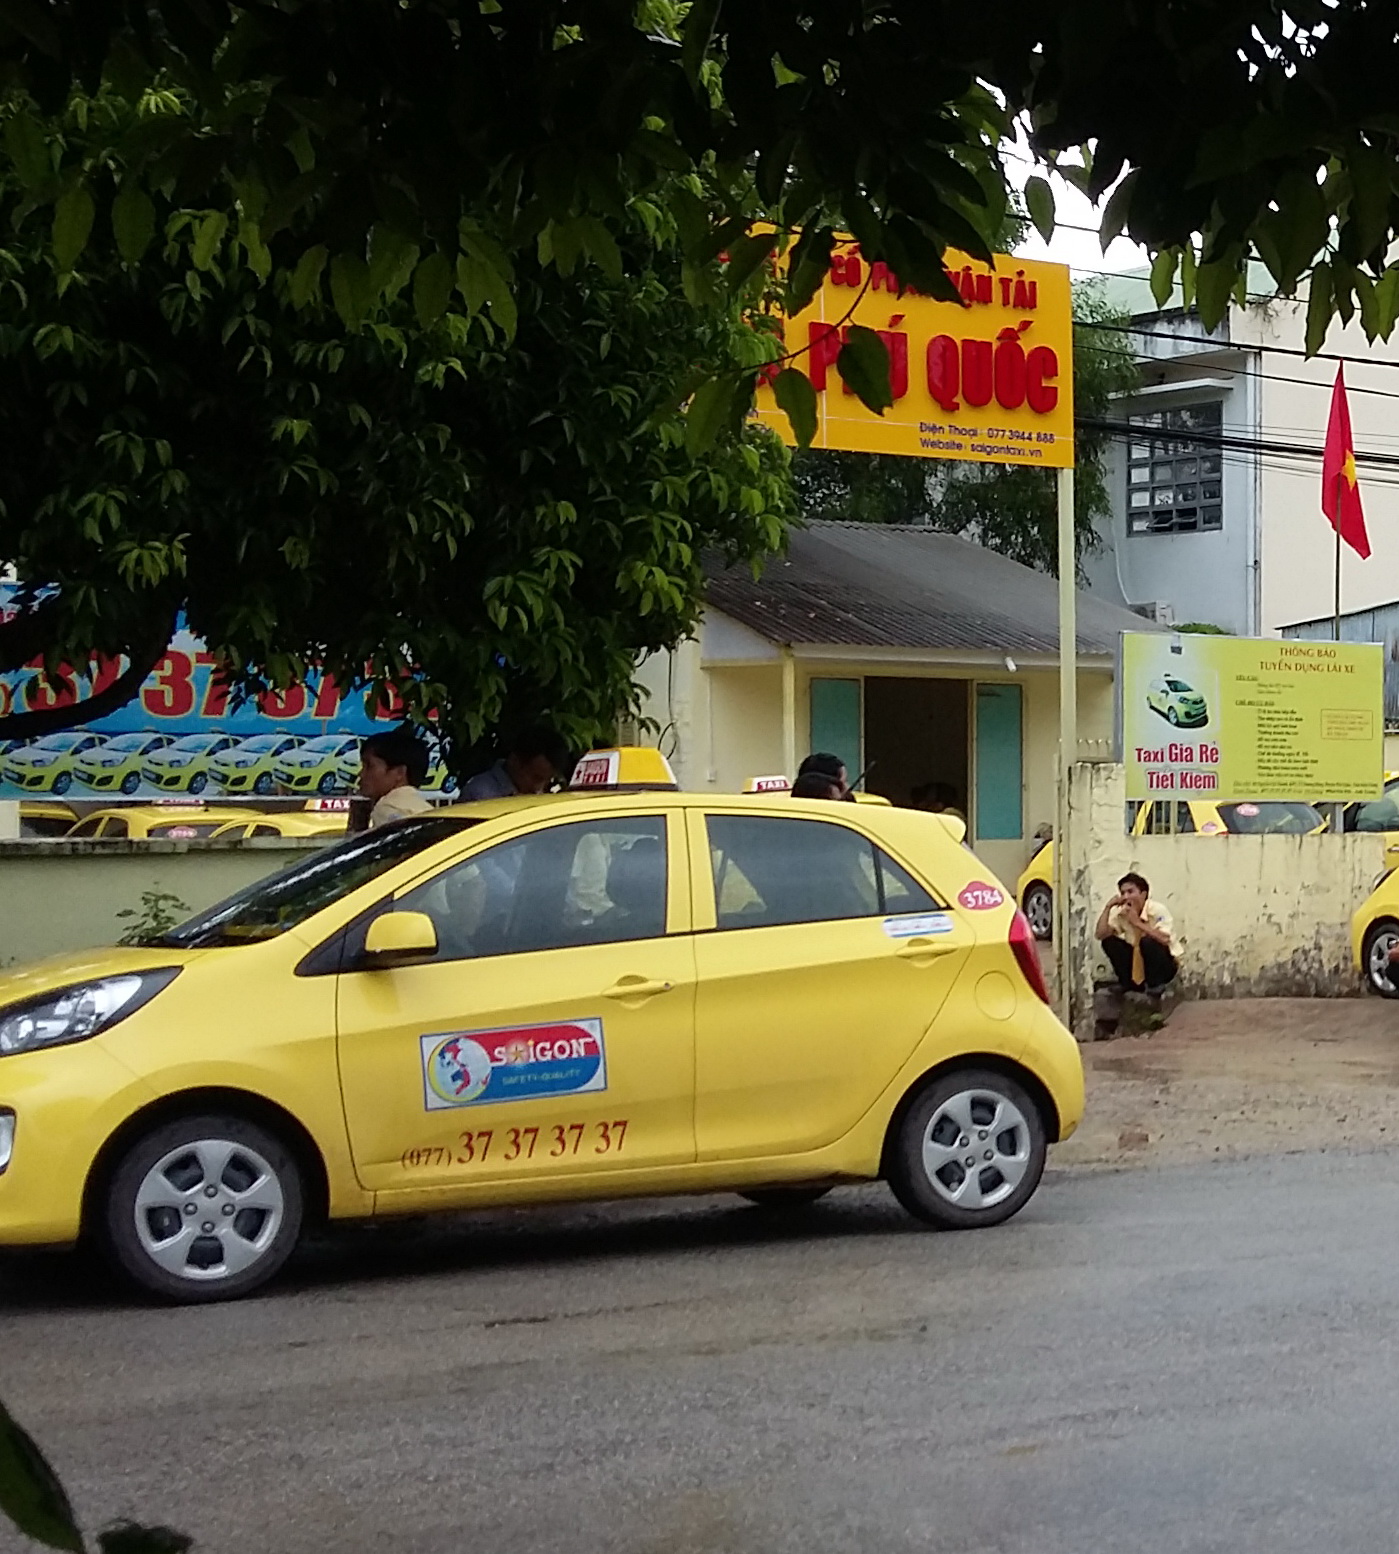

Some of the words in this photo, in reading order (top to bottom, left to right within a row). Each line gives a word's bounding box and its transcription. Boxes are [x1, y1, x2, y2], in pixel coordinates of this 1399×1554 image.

[808, 314, 908, 400] PÚ
[927, 319, 1059, 414] QUỐC
[970, 442, 1043, 457] saigontaxi.vn
[1280, 646, 1314, 658] THÔNG
[1317, 647, 1337, 658] BÁO
[1295, 662, 1324, 673] DỤNG
[1344, 664, 1356, 673] XE
[1135, 747, 1165, 763] Taxi
[760, 780, 786, 790] TAXI
[325, 799, 350, 809] TAX
[963, 889, 1003, 908] 3784
[400, 1146, 453, 1169] (077)
[457, 1130, 494, 1165] 37
[504, 1126, 540, 1161] 37
[550, 1122, 586, 1158] 37
[594, 1119, 629, 1155] 37
